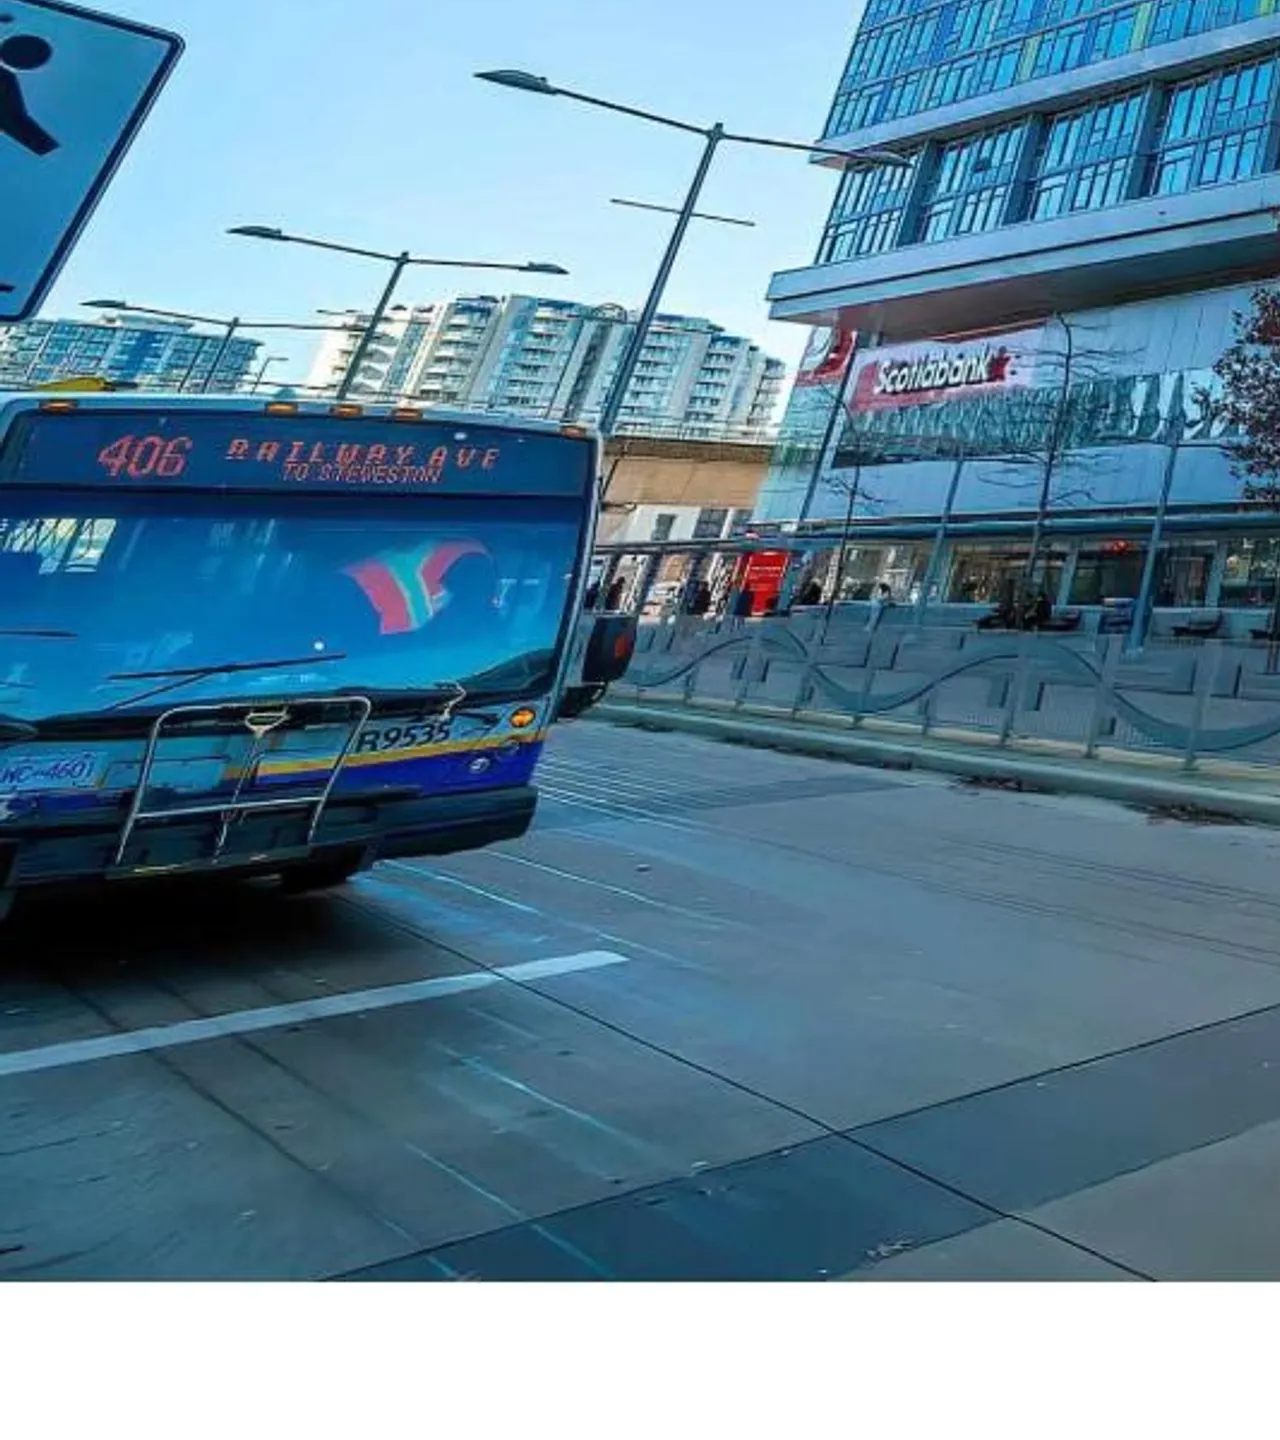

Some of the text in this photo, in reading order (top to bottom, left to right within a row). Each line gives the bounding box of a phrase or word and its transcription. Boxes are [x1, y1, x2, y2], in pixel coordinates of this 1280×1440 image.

[873, 354, 992, 395] Scotiabank
[98, 435, 500, 477] 406 RAILWAY AVE
[356, 721, 452, 753] R9535
